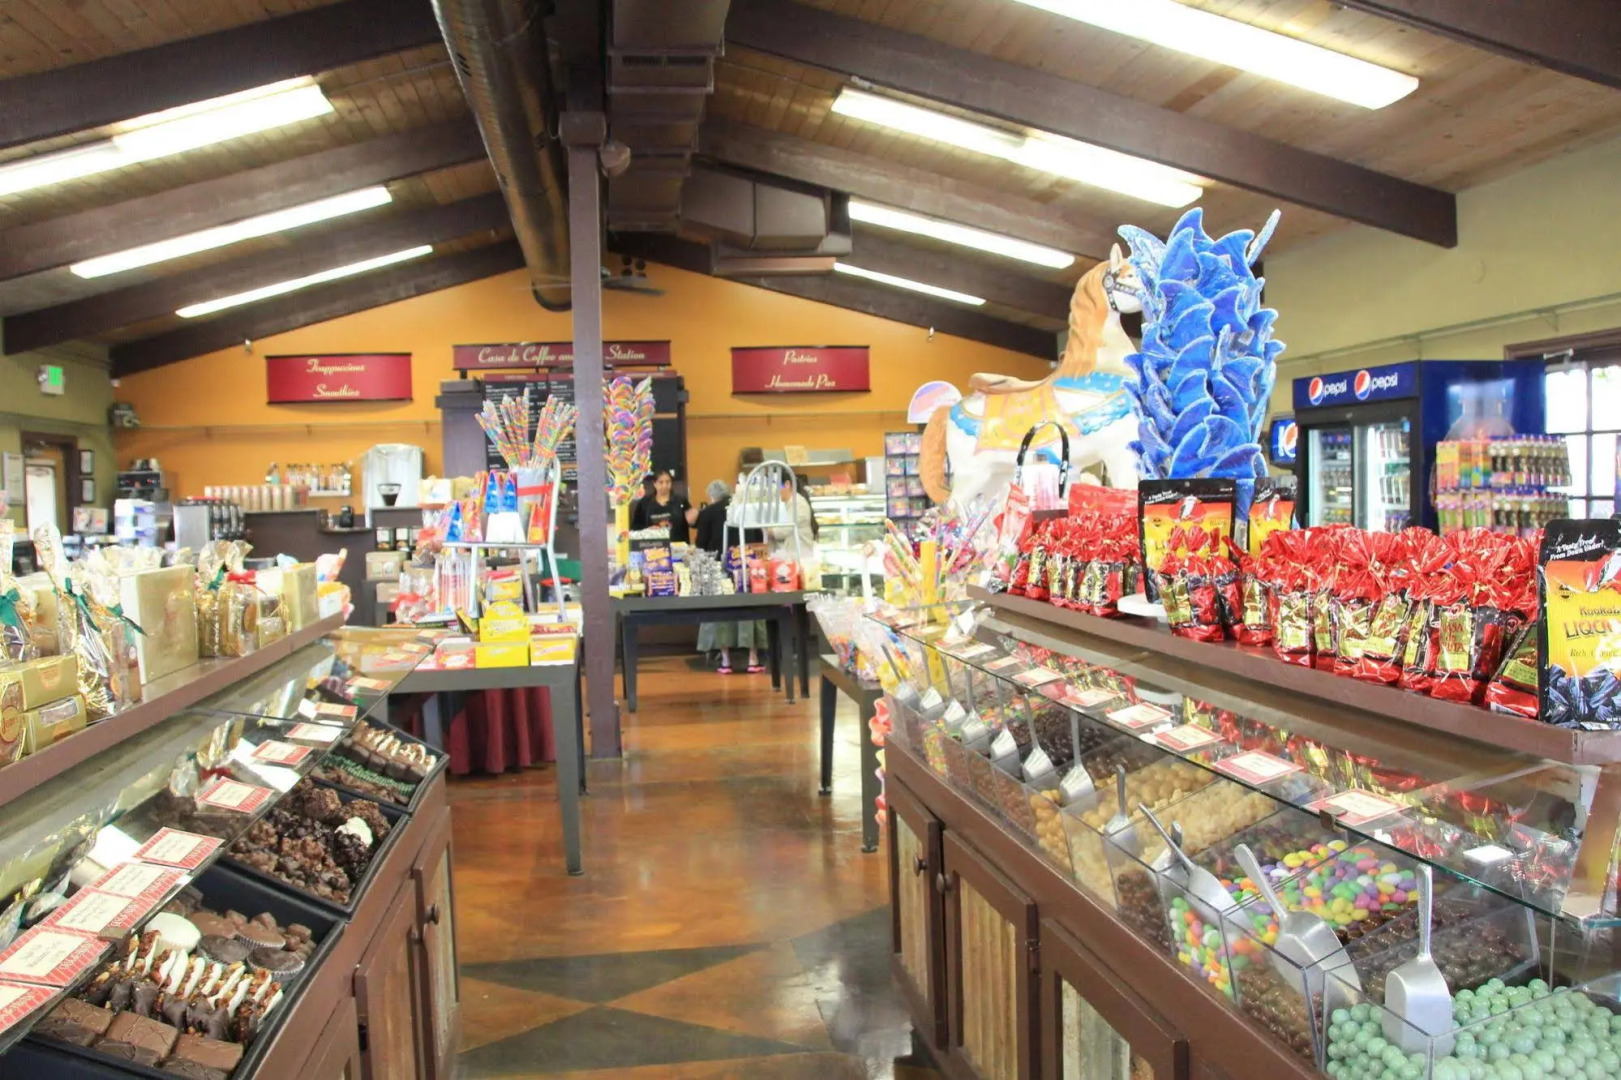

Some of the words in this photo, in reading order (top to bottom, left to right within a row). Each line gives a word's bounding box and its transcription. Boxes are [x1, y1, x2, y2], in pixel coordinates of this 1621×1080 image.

[478, 346, 505, 363] Casa
[507, 348, 519, 361] de
[522, 345, 556, 365] Coffee
[604, 344, 645, 360] Station
[783, 350, 818, 366] Pastries
[764, 374, 815, 388] Homemade
[815, 373, 836, 389] Pies
[1323, 379, 1347, 397] pepsi
[1371, 371, 1398, 391] pepsi
[312, 383, 361, 398] Smoothies
